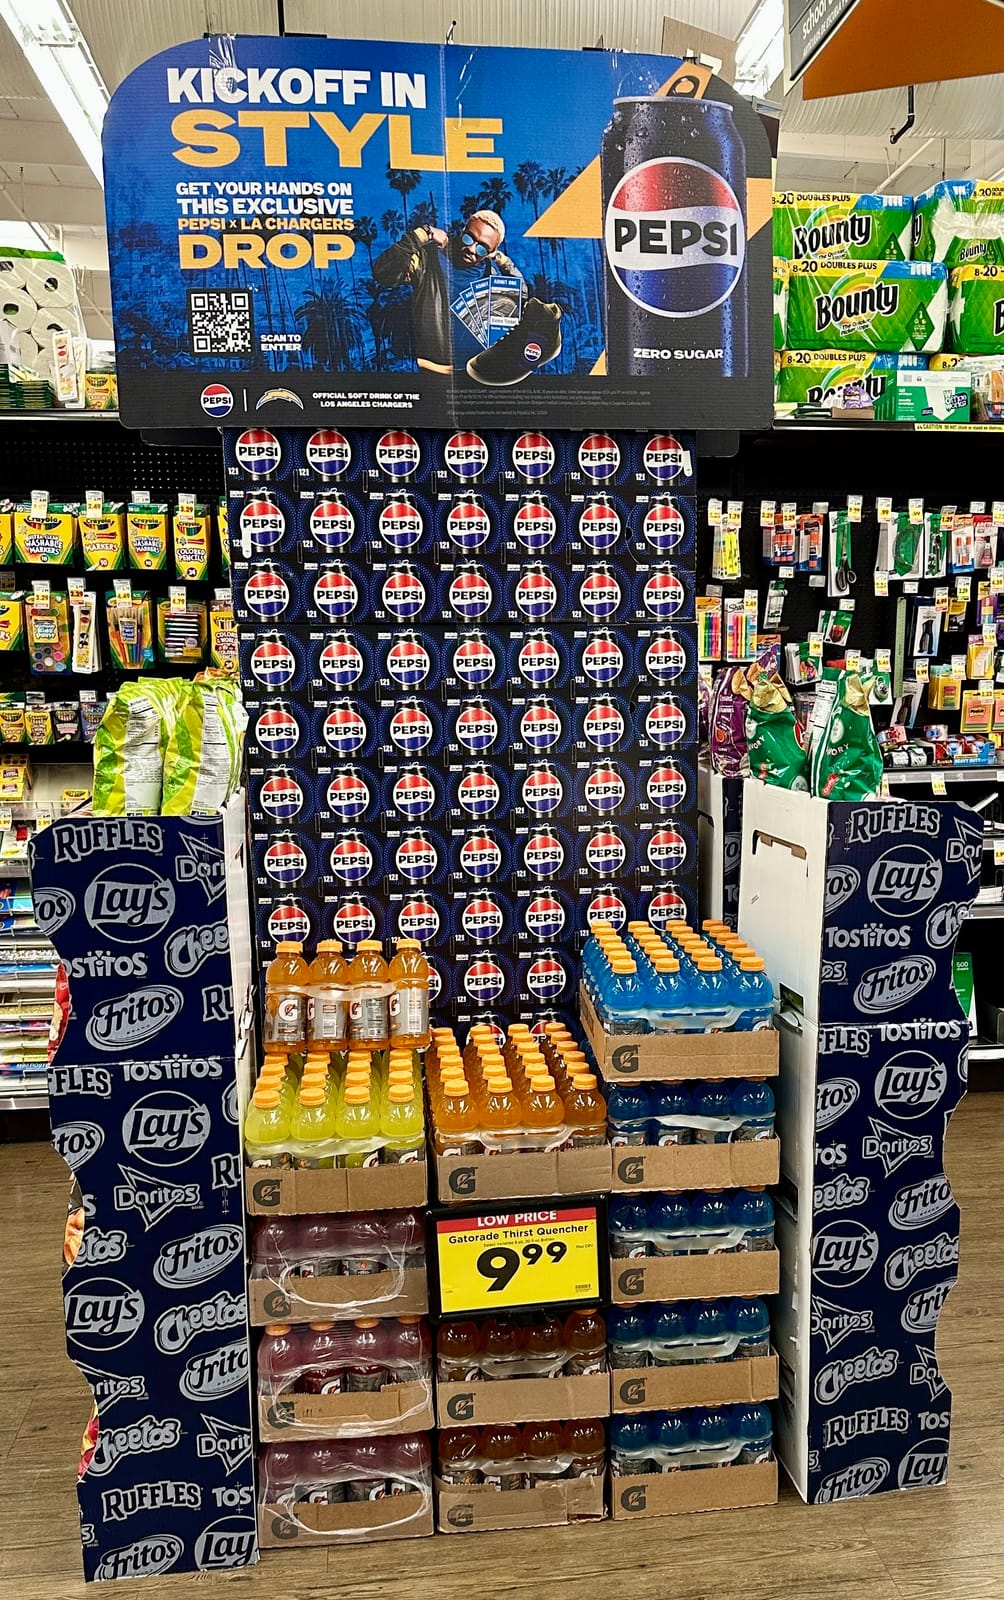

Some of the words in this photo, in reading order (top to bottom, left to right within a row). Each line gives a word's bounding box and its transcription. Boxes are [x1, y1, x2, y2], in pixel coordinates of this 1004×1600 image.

[167, 67, 372, 105] KICKOFF
[381, 71, 426, 110] IN
[171, 109, 504, 172] STYLE
[176, 182, 211, 196] GET
[214, 182, 261, 196] YOUR
[265, 182, 324, 196] HANDS
[328, 182, 352, 195] ON
[797, 194, 830, 202] DOUBLES
[177, 198, 229, 214] THIS
[233, 199, 353, 215] EXCLUSIVE
[178, 218, 225, 230] PEPSI
[241, 218, 262, 230] LA
[265, 218, 354, 231] CHARGERS
[614, 218, 738, 257] PEPSI
[794, 214, 871, 260] Bounty
[179, 234, 355, 270] DROP
[959, 243, 987, 261] Bounty
[815, 281, 899, 332] Bounty
[260, 334, 286, 343] SCAN
[288, 334, 301, 343] TO
[261, 343, 302, 351] ENTER
[633, 347, 672, 360] ZERO
[674, 347, 724, 360] SUGAR
[813, 353, 847, 361] DOUBLES
[848, 353, 866, 361] PLUS
[202, 395, 231, 406] PEPSI
[312, 392, 346, 400] OFFICIAL
[348, 392, 368, 400] SOFT
[369, 392, 392, 400] DRINK
[394, 392, 403, 400] OF
[405, 392, 420, 400] THE
[320, 401, 336, 409] LOS
[337, 401, 371, 409] ANGELES
[372, 401, 413, 409] CHARGERS
[239, 446, 278, 457] PEPSI
[309, 448, 348, 458] PEPSI
[379, 449, 417, 459] PEPSI
[448, 450, 485, 460] PEPSI
[515, 451, 552, 461] PEPSI
[581, 452, 617, 463] PEPSI
[646, 453, 682, 464] PEPSI
[27, 515, 58, 523] Crayola
[25, 540, 63, 549] WASHABLE
[86, 543, 118, 551] MARKERS
[254, 660, 292, 669] PEPSI
[323, 659, 360, 669] PEPSI
[390, 659, 427, 668] PEPSI
[456, 658, 492, 668] PEPSI
[522, 657, 556, 667] PEPSI
[585, 657, 620, 666] PEPSI
[649, 656, 683, 665] PEPSI
[850, 804, 940, 842] RUFFLES
[55, 819, 163, 862] RUFFLES
[333, 856, 370, 866] PEPSI
[399, 855, 434, 864] PEPSI
[463, 853, 498, 863] PEPSI
[527, 851, 561, 861] PEPSI
[589, 849, 623, 858] PEPSI
[650, 846, 684, 856] PEPSI
[178, 858, 225, 879] Dori
[267, 858, 304, 868] PEPSI
[872, 861, 939, 902] Lay's
[92, 880, 170, 927] Lay's
[166, 922, 229, 976] Chee
[862, 961, 930, 1004] Fritos
[92, 992, 177, 1038] Fritos
[612, 1044, 639, 1073] G
[879, 1065, 943, 1105] Lay's
[128, 1106, 206, 1151] Lay's
[865, 1137, 931, 1156] Doritos
[617, 1156, 645, 1184] G
[448, 1166, 476, 1195] G
[117, 1185, 198, 1207] Doritos
[253, 1178, 281, 1207] G
[814, 1177, 869, 1208] eetos
[897, 1178, 951, 1218] Frito
[477, 1215, 509, 1227] LOW
[514, 1210, 557, 1224] PRICE
[449, 1231, 499, 1244] Gatorade
[503, 1228, 533, 1240] Thirst
[537, 1224, 589, 1237] Quencher
[161, 1231, 241, 1277] Fritos
[814, 1235, 875, 1273] Lay's
[886, 1237, 958, 1290] Cheeto
[476, 1246, 520, 1293] 9
[66, 1293, 141, 1335] Lay's
[189, 1349, 248, 1390] Frito
[816, 1347, 898, 1405] Cheetos
[92, 1376, 144, 1397] ritos
[620, 1378, 646, 1405] G
[827, 1408, 909, 1447] RUFFLES
[198, 1433, 252, 1457] Dorit
[904, 1455, 947, 1485] Lay
[821, 1460, 885, 1502] Fritos
[102, 1481, 201, 1523] RUFFLES
[100, 1539, 178, 1580] Fritos
[201, 1533, 255, 1567] Lay
